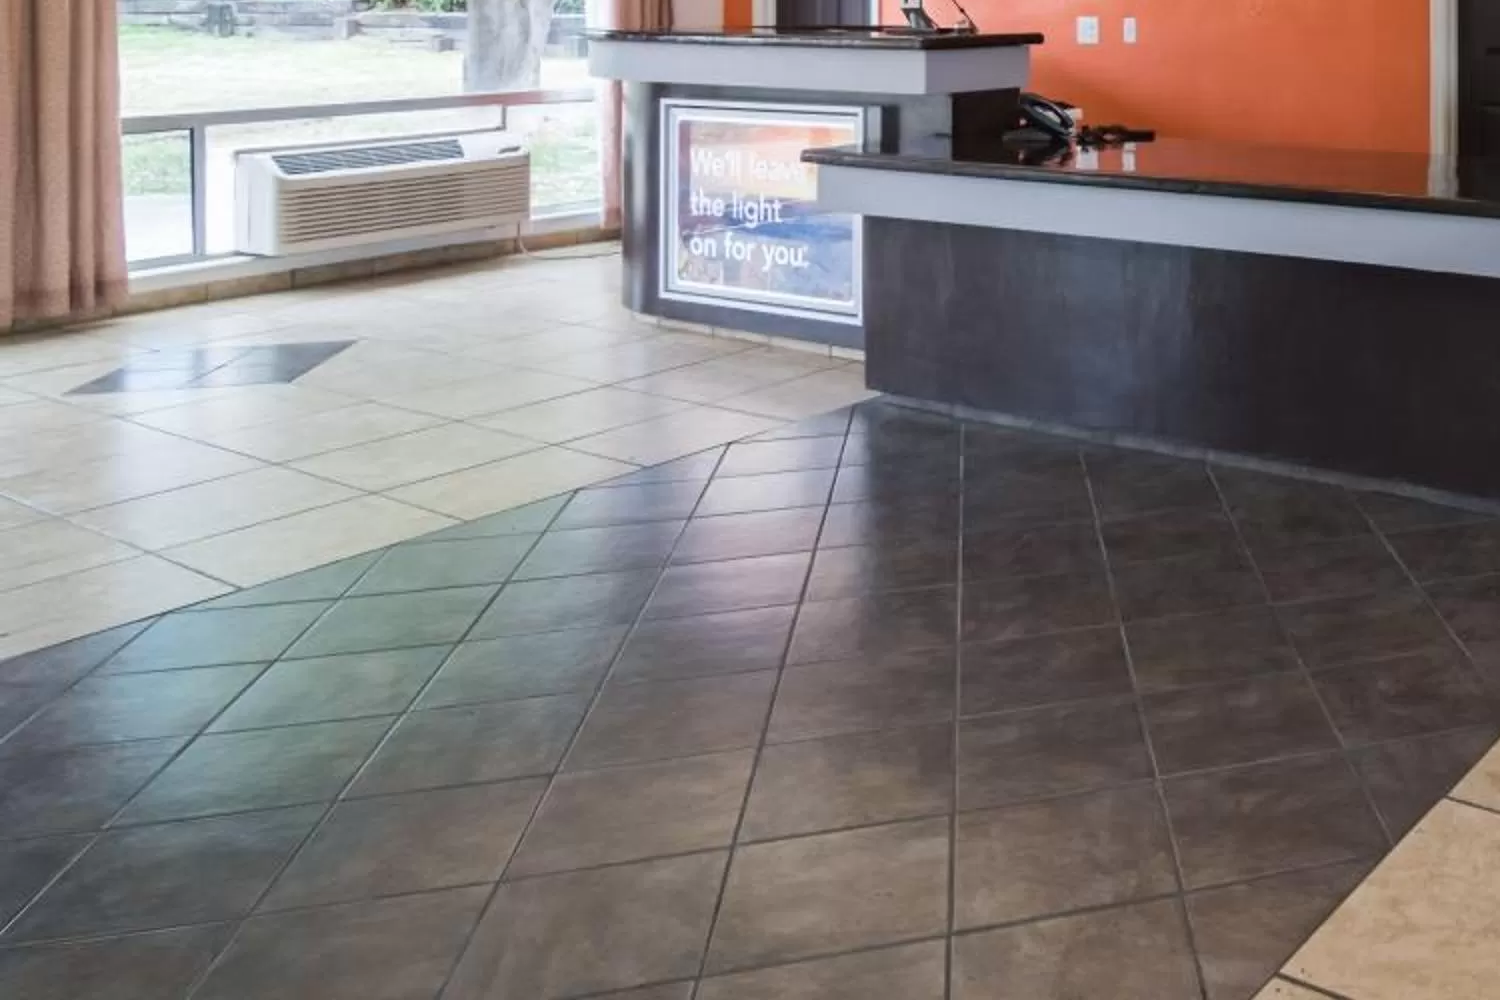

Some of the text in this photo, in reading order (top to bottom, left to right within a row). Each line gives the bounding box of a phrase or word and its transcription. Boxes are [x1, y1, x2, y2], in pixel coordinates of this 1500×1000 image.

[691, 147, 741, 178] We'll
[691, 187, 783, 228] the light
[690, 236, 717, 258] on
[724, 231, 755, 261] for
